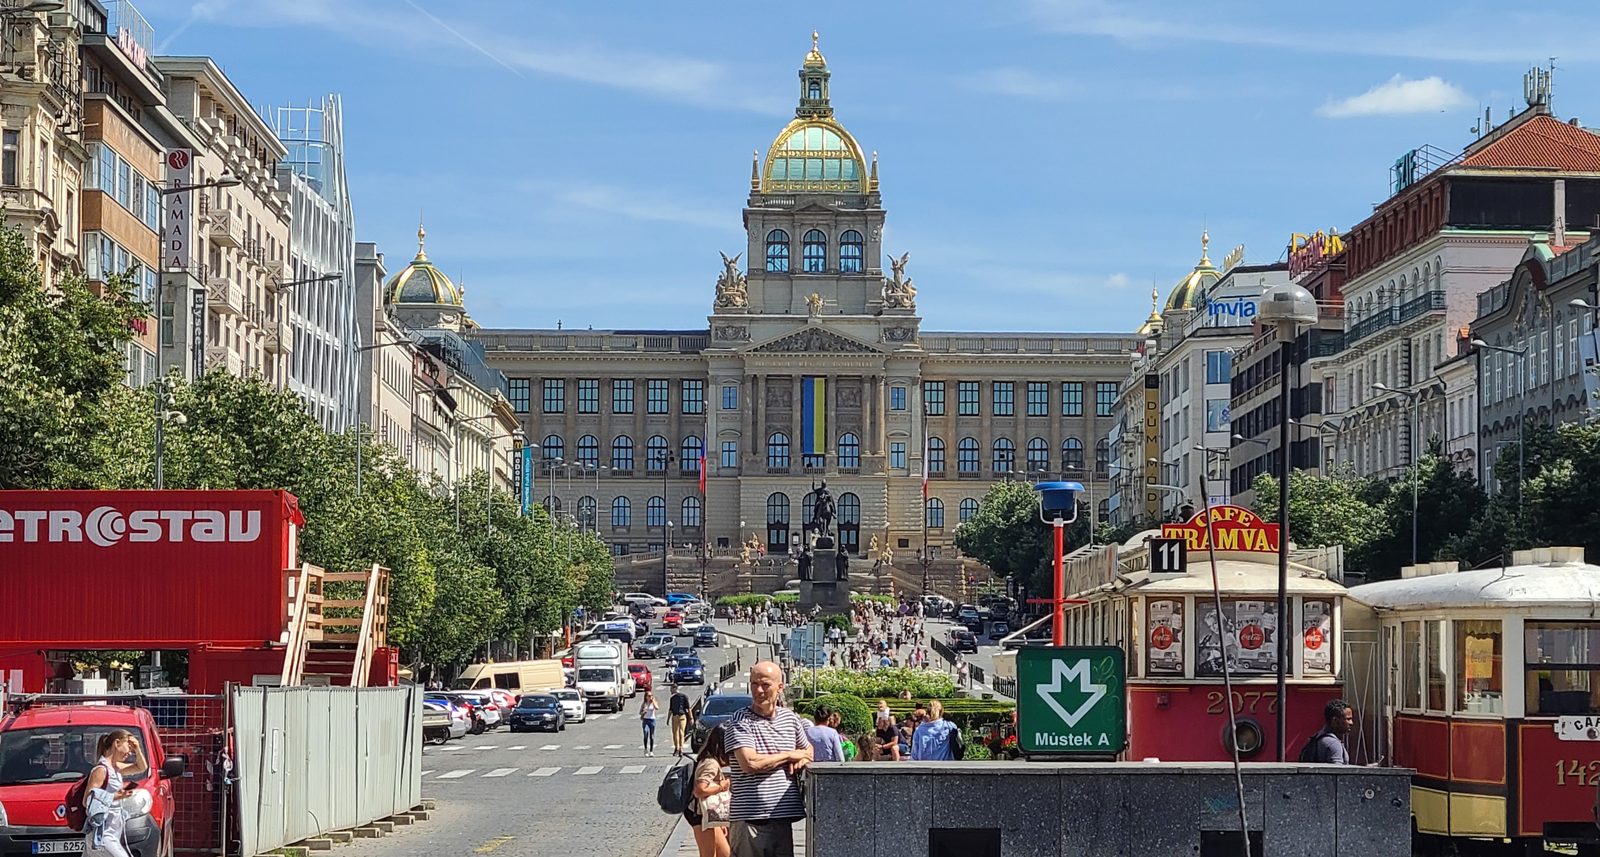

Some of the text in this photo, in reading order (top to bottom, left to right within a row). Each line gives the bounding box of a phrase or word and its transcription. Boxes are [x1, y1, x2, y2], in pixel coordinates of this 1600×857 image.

[171, 179, 184, 267] RAMADA
[1208, 297, 1256, 318] invia
[1195, 507, 1255, 528] CAFE
[1159, 541, 1180, 570] 11
[1207, 691, 1279, 714] 2077
[1035, 732, 1110, 746] Můstek A
[1556, 760, 1600, 786] 142
